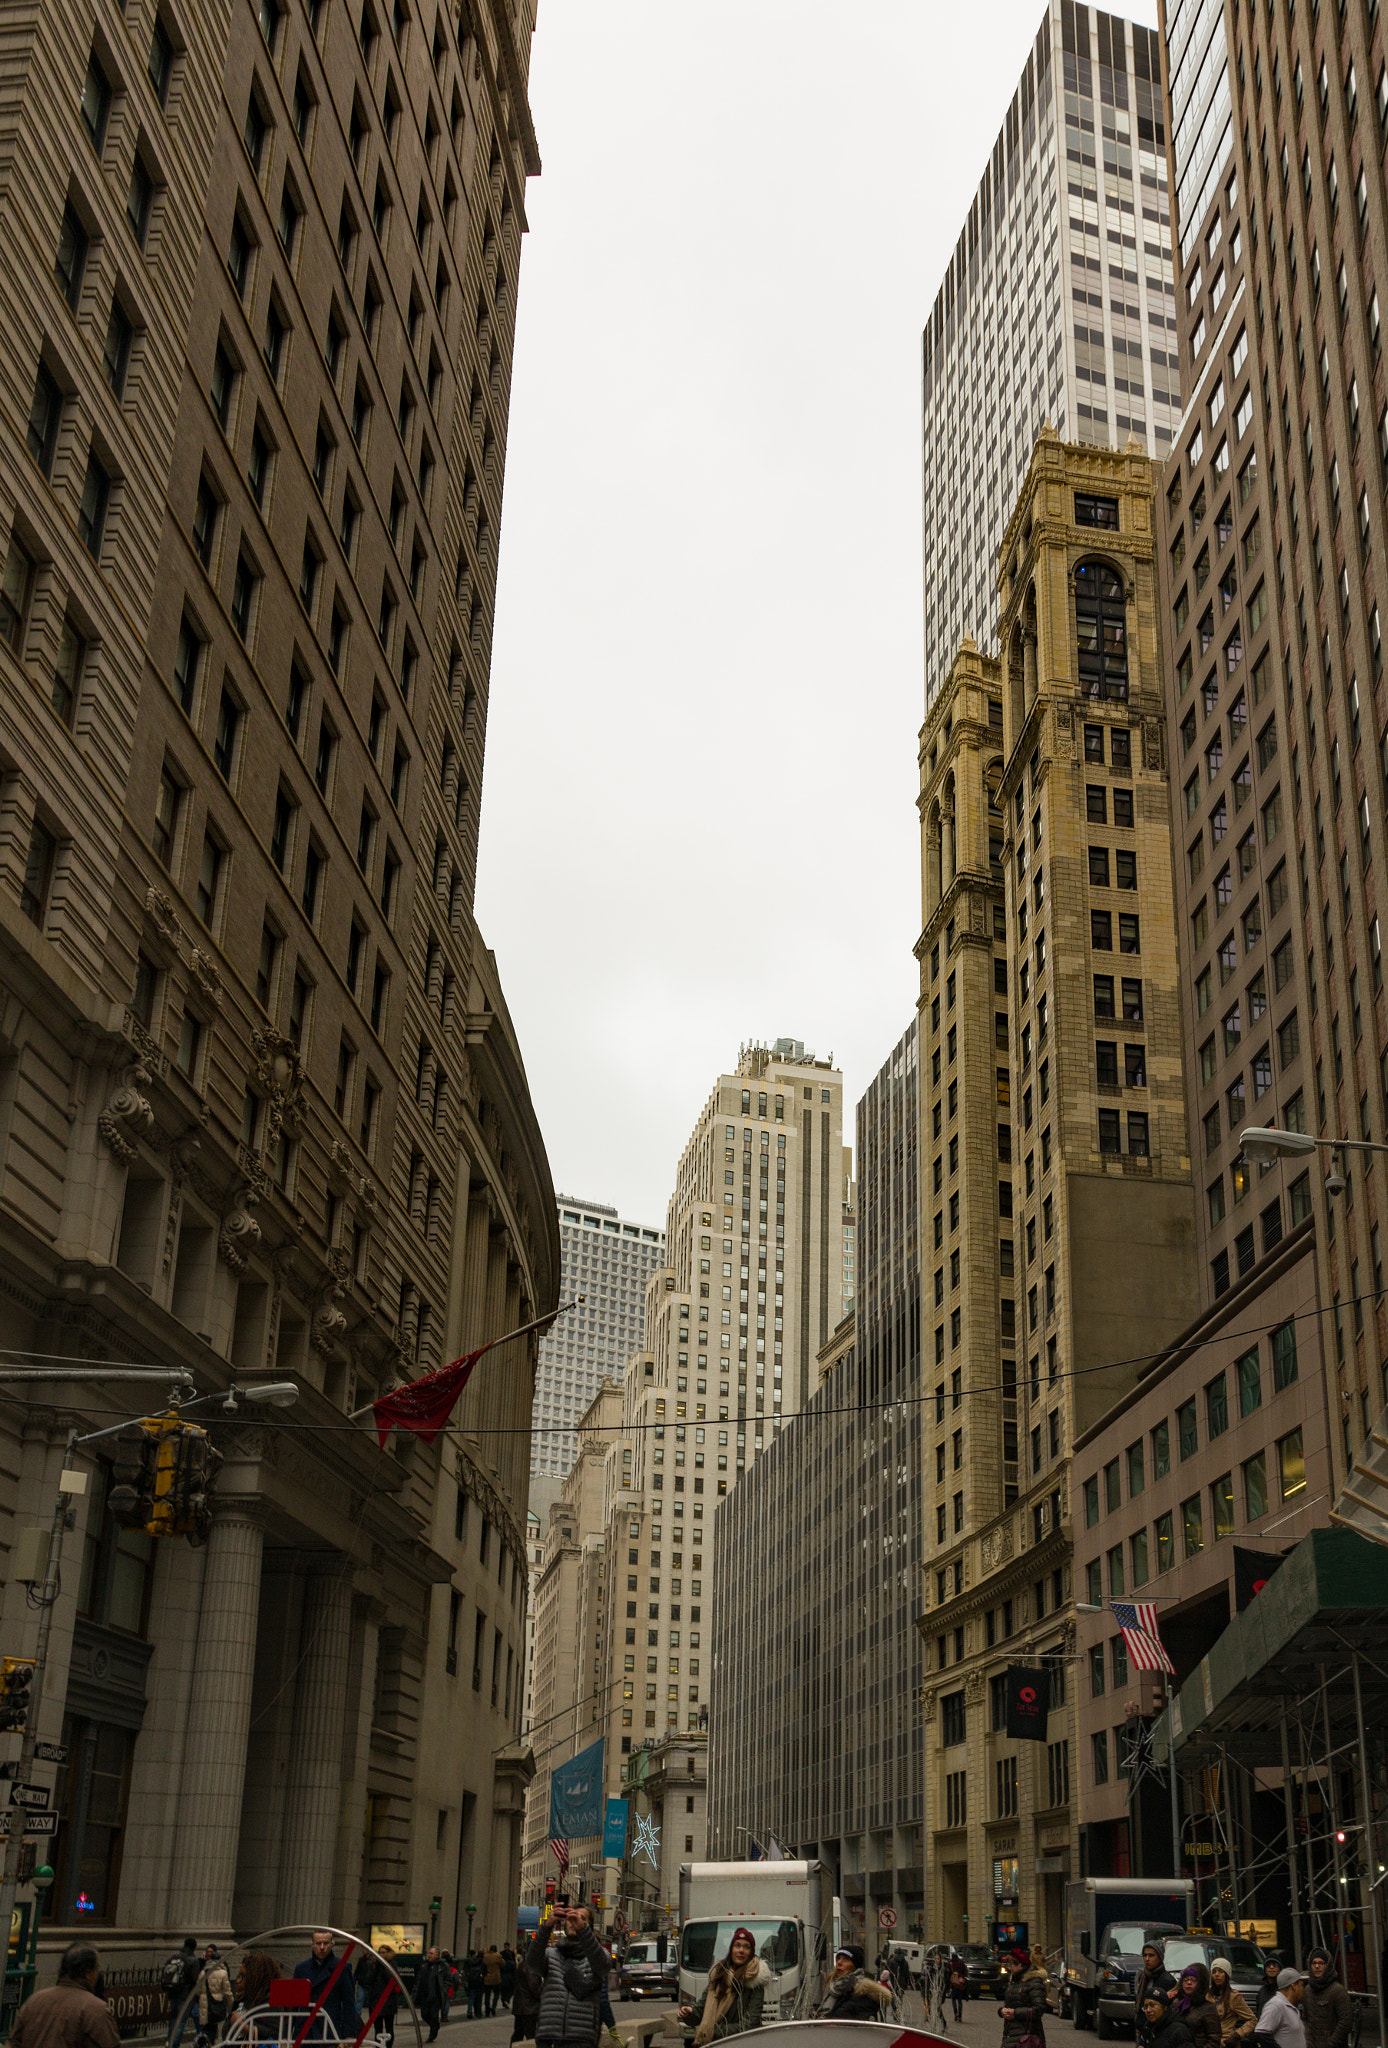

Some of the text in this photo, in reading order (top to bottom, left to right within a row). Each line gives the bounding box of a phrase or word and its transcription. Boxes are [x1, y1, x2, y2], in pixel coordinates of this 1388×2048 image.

[42, 1746, 62, 1761] BROAD
[16, 1790, 45, 1803] ONE WAY
[28, 1818, 51, 1828] WAY
[994, 1838, 1016, 1853] SARAR
[108, 1994, 153, 2018] BOBBY
